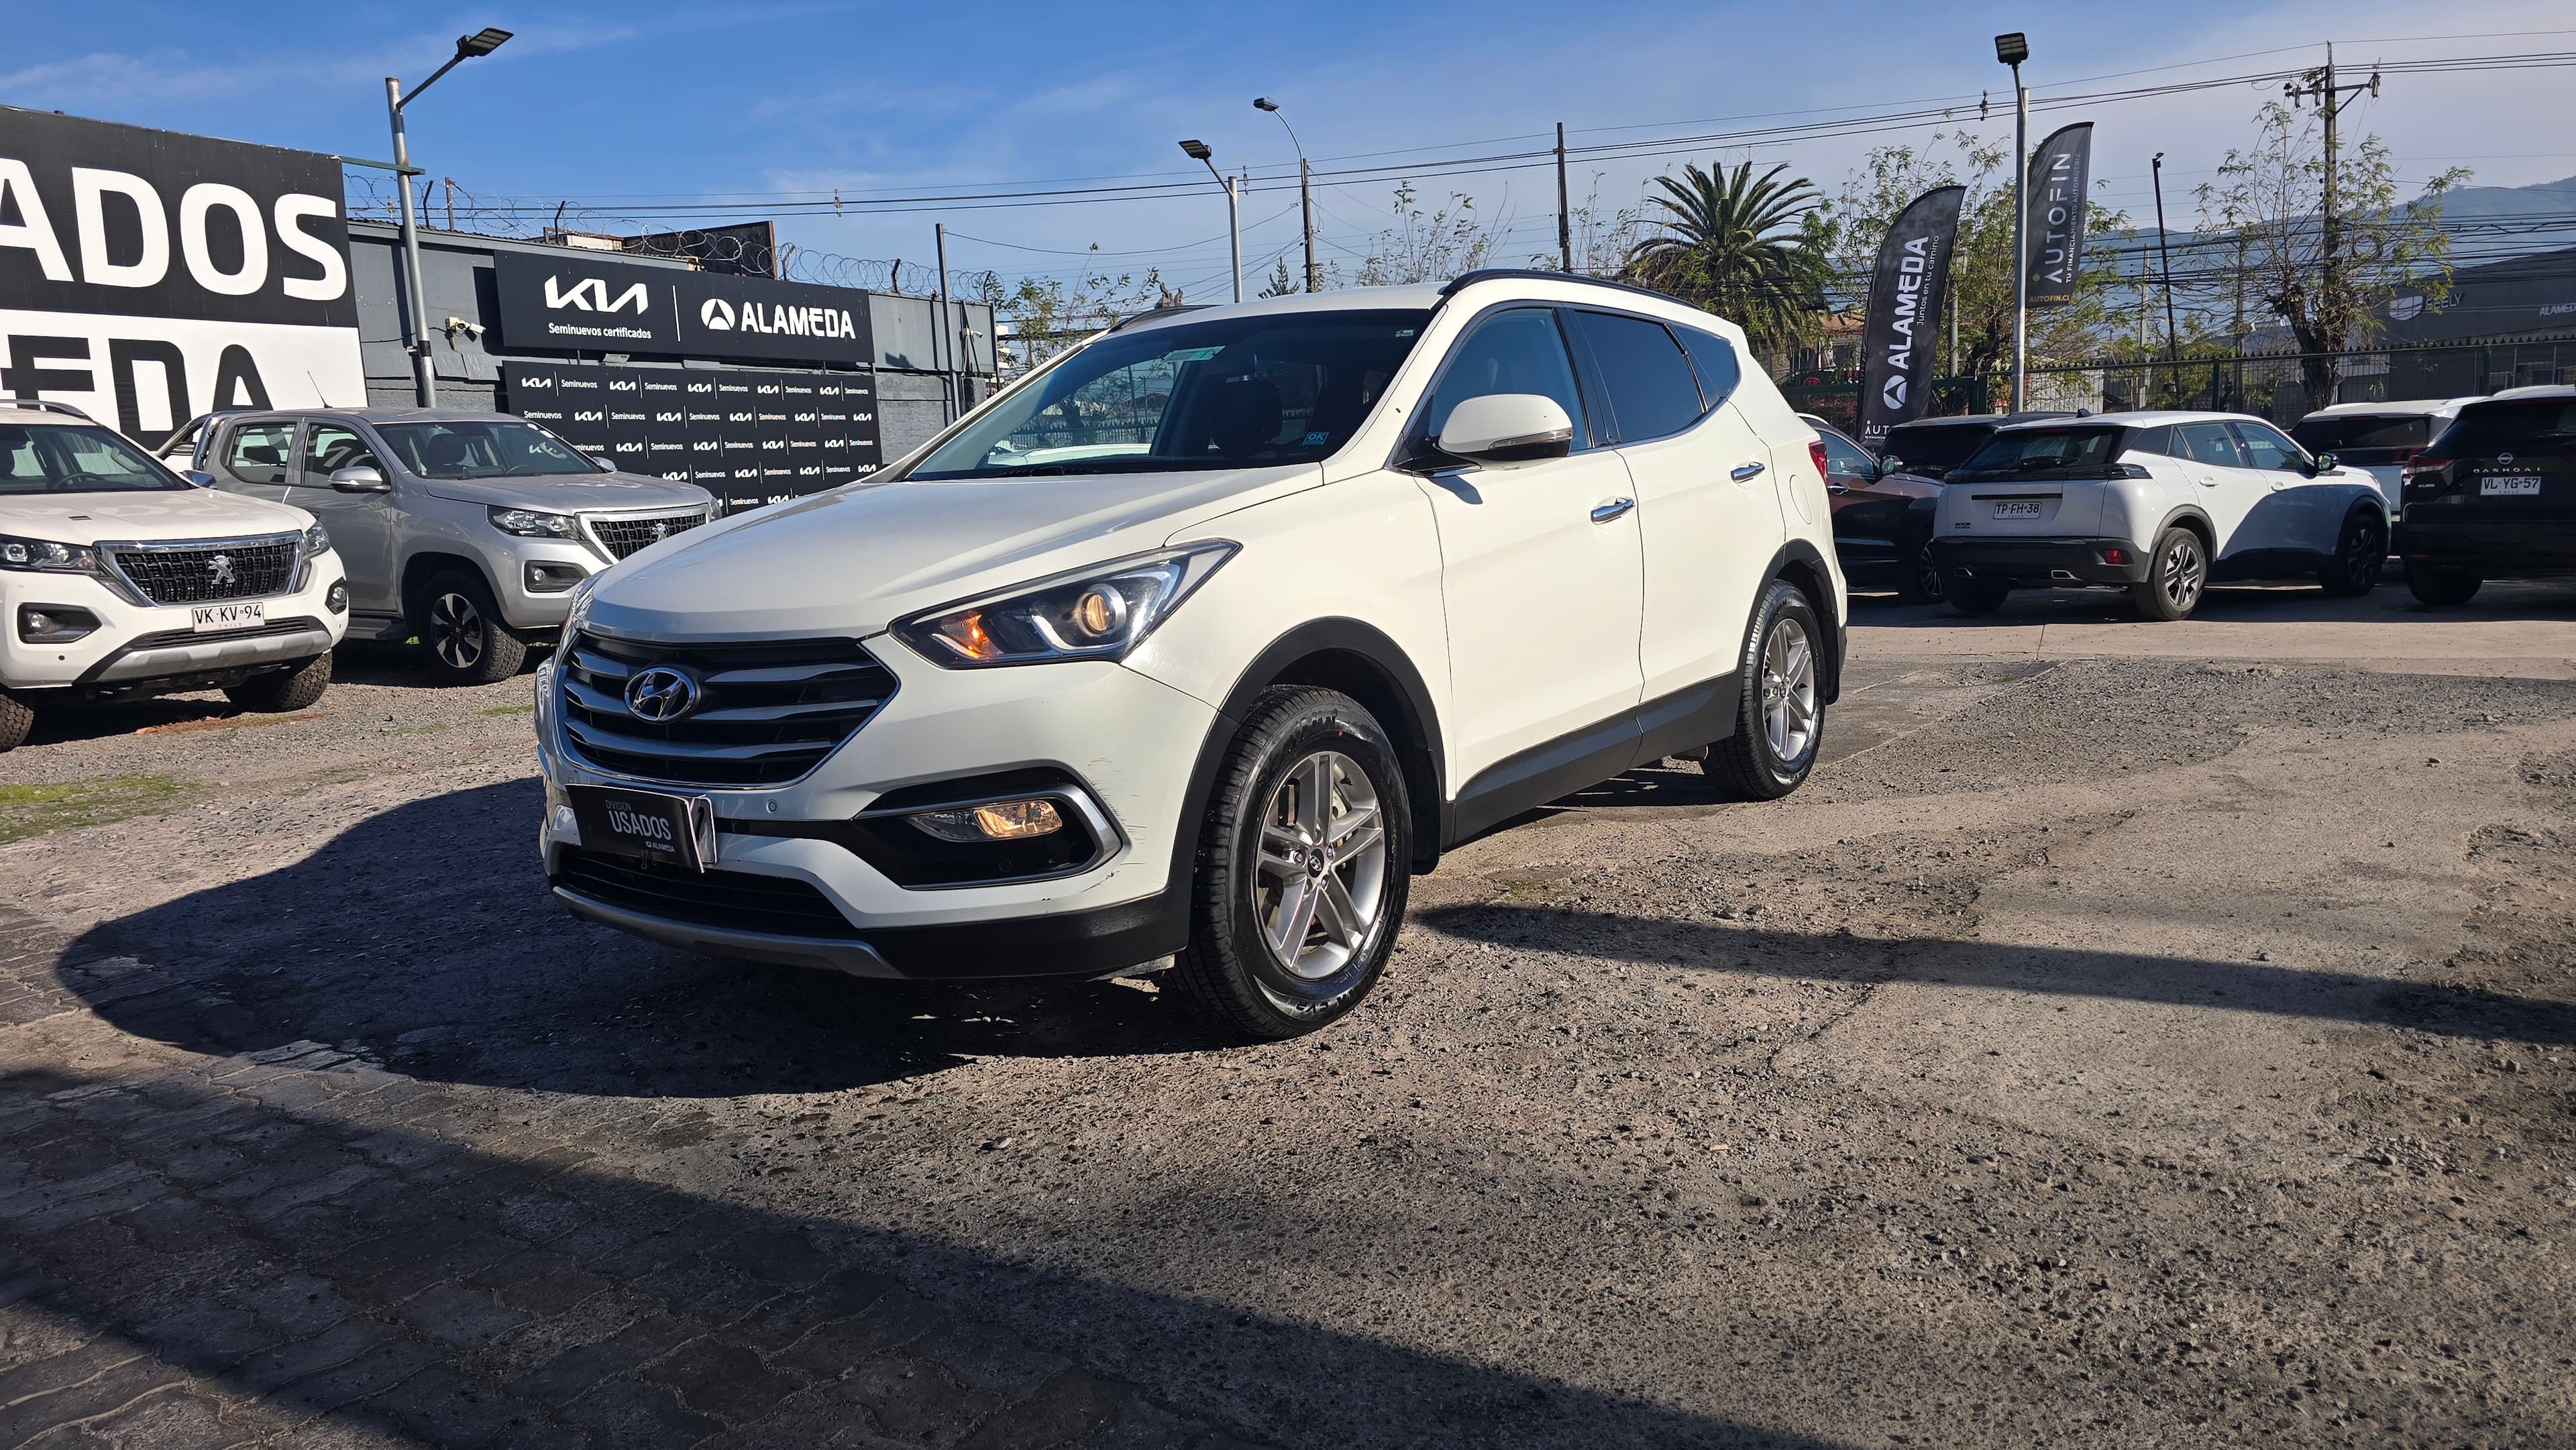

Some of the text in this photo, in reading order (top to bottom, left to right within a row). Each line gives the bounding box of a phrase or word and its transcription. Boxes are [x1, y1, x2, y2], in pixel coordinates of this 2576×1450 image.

[2043, 153, 2072, 283] AUTOFIN
[1917, 235, 1939, 326] Juntos en tu camino
[2065, 274, 2072, 283] TU
[544, 275, 649, 315] KIA
[1886, 236, 1929, 370] ALAMEDA
[741, 301, 856, 339] ALAMEDA
[548, 322, 652, 339] Seminuevos certificados
[561, 379, 598, 389] Seminuevos
[645, 382, 677, 392] Seminuevos
[718, 384, 749, 393] Seminuevos
[785, 386, 812, 394] Seminuevos
[845, 387, 869, 395] Seminuevos
[524, 410, 562, 420] Seminuevos
[611, 412, 645, 421] Seminuevos
[689, 413, 720, 421] Seminuevos
[759, 413, 786, 421] Seminuevos
[820, 413, 847, 421] Seminuevos
[1308, 433, 1324, 441] OK
[573, 443, 604, 452] minuevos
[650, 443, 684, 451] Seminuevos
[724, 441, 754, 449] Seminuevos
[695, 471, 726, 479] Seminuevos
[764, 468, 792, 476] Seminuevos
[729, 498, 759, 506] Seminuevos
[608, 810, 672, 842] USADOS
